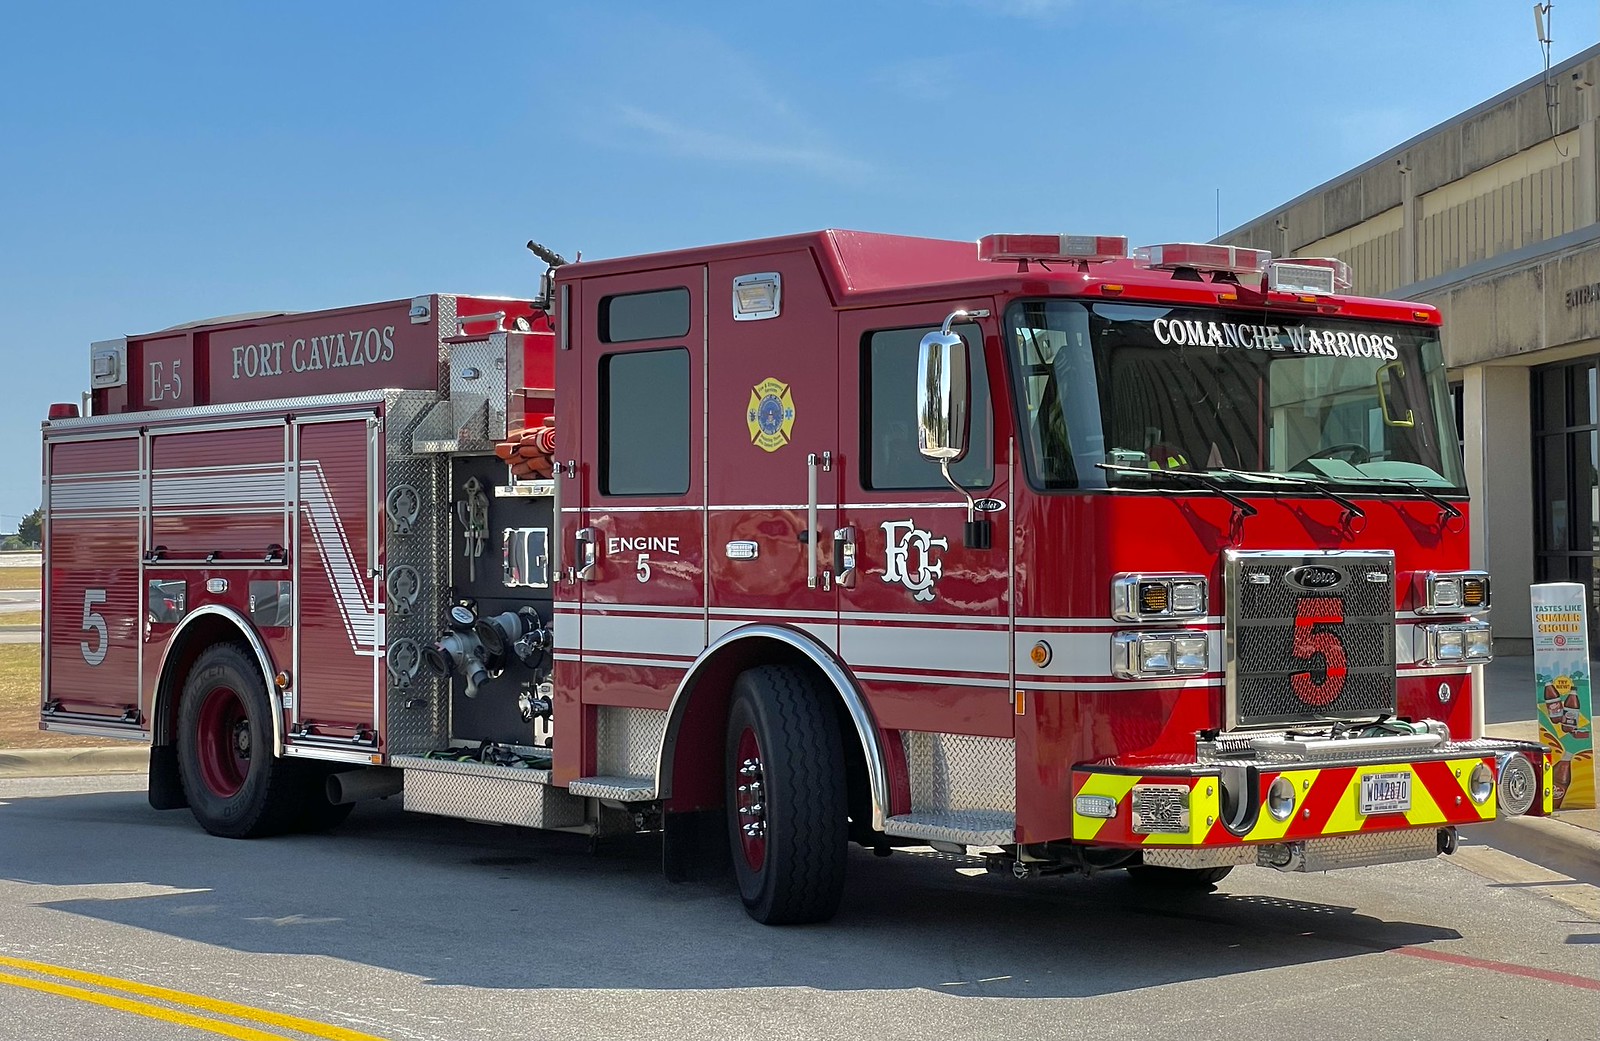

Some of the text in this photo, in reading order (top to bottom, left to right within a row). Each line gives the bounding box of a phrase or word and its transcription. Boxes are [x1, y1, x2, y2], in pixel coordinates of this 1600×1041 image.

[232, 325, 395, 379] FORT CAVAZOS
[1153, 318, 1398, 360] COMANCHE WARRIORS
[149, 358, 182, 402] E-5
[608, 536, 680, 555] ENGINE
[636, 553, 651, 583] 5
[1299, 567, 1337, 584] Pierce
[1536, 613, 1582, 622] SUMMER
[1564, 604, 1582, 612] LIKE
[80, 589, 108, 666] 5
[1538, 623, 1580, 633] SHOULD
[1290, 598, 1347, 706] 5
